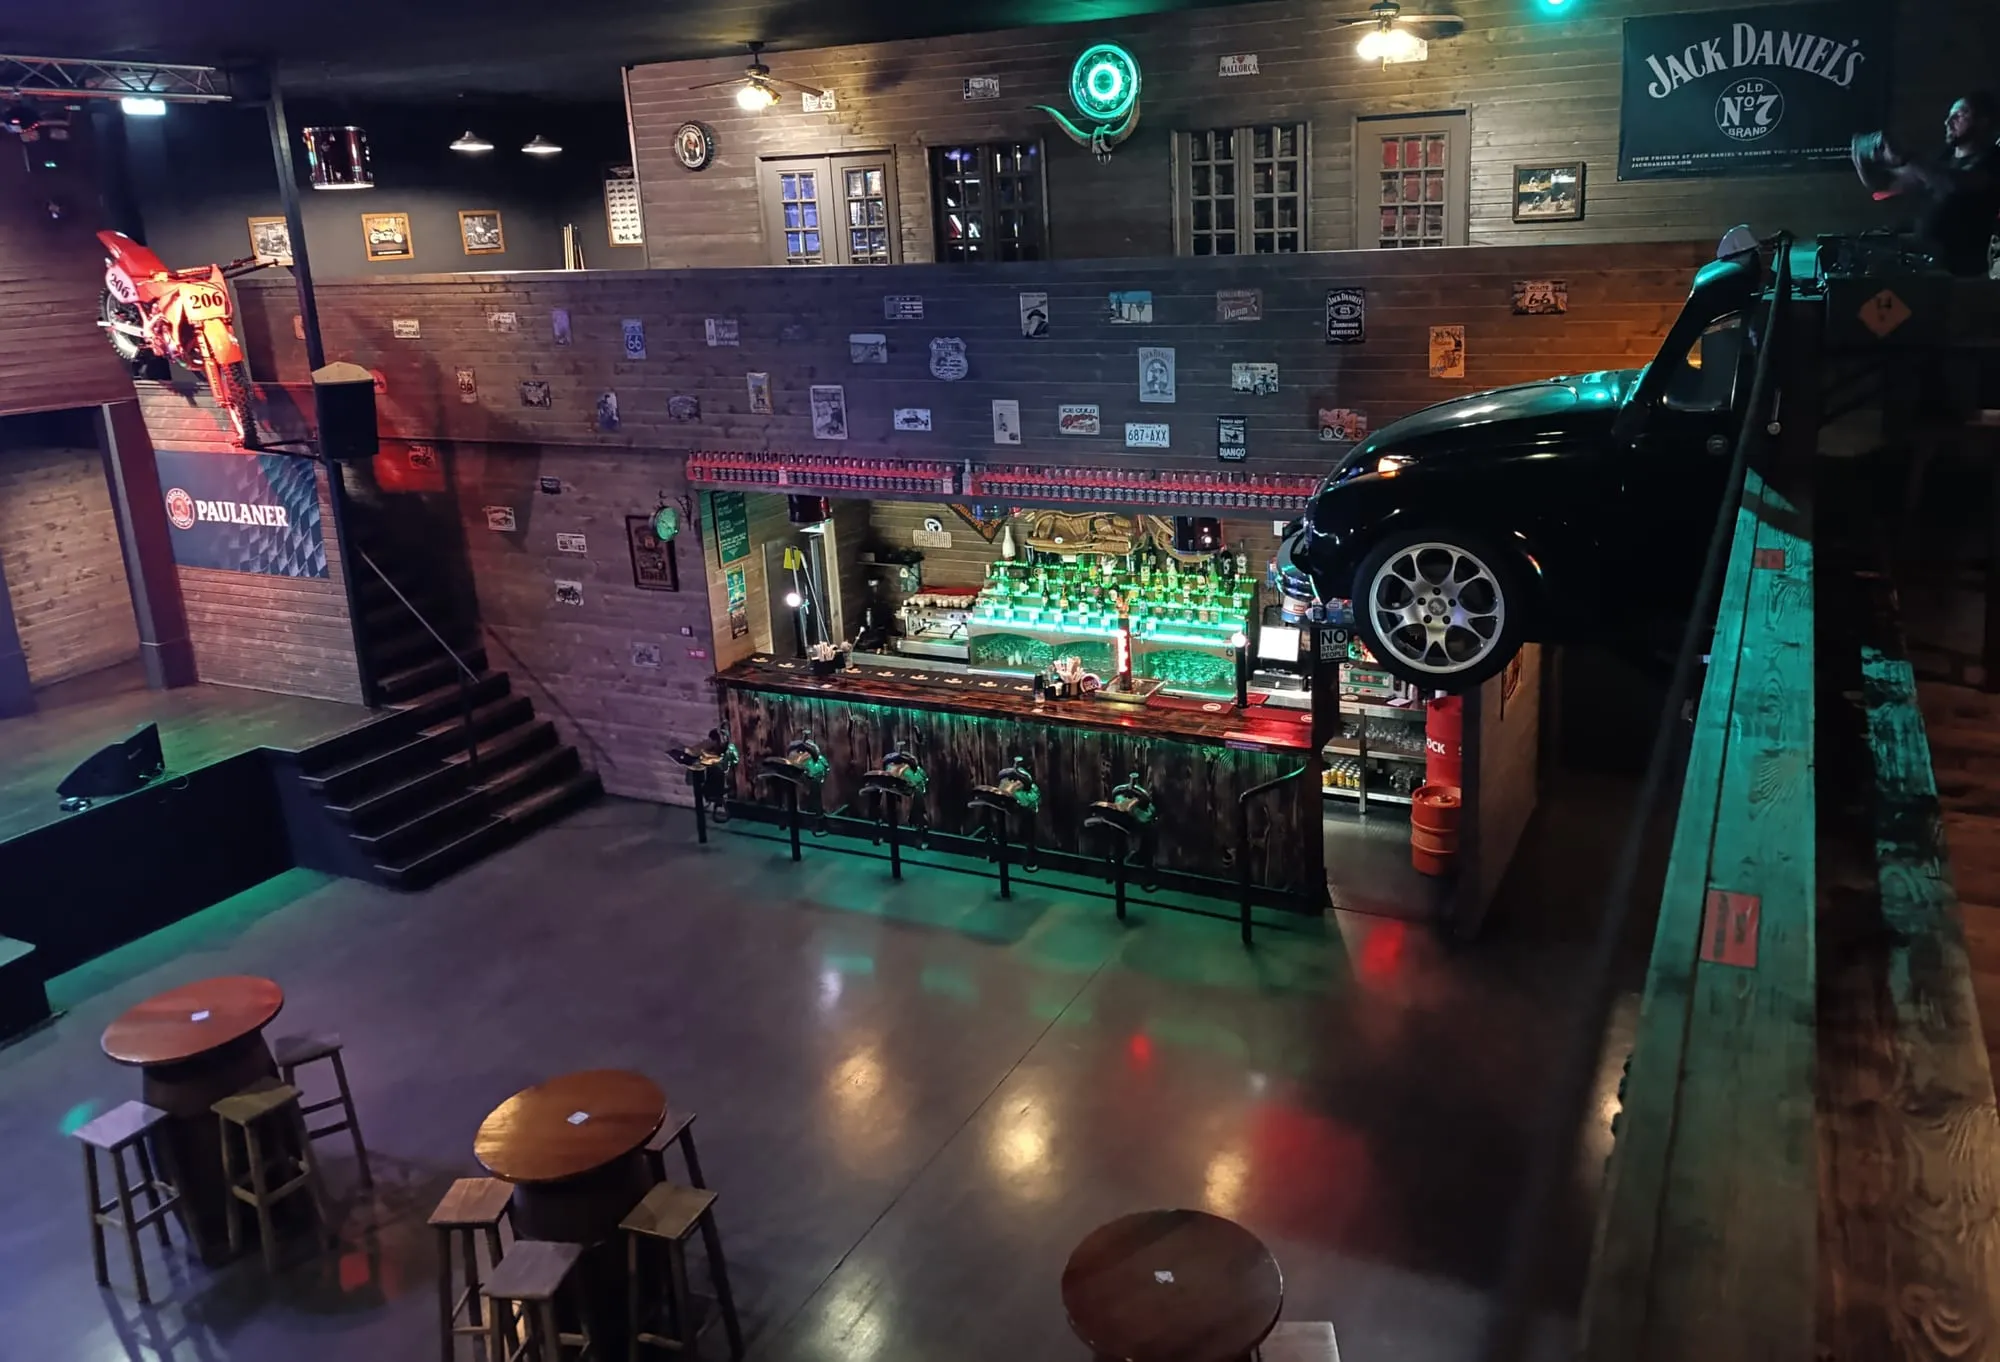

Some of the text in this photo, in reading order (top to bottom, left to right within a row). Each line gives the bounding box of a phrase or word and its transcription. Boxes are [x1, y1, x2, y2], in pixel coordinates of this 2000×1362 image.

[1645, 22, 1866, 98] JACK DANIEL'S
[1221, 63, 1258, 73] MALLORCA
[1736, 82, 1764, 94] OLD
[1728, 126, 1767, 138] BRAND
[110, 273, 130, 299] 206
[190, 291, 223, 309] 206
[1528, 292, 1551, 306] 66
[627, 335, 642, 350] 66
[1220, 447, 1246, 457] DJANGO
[195, 499, 289, 527] PAULANER
[1321, 630, 1347, 645] NO
[1322, 644, 1347, 652] STUPID
[1322, 651, 1347, 659] PEOPLE
